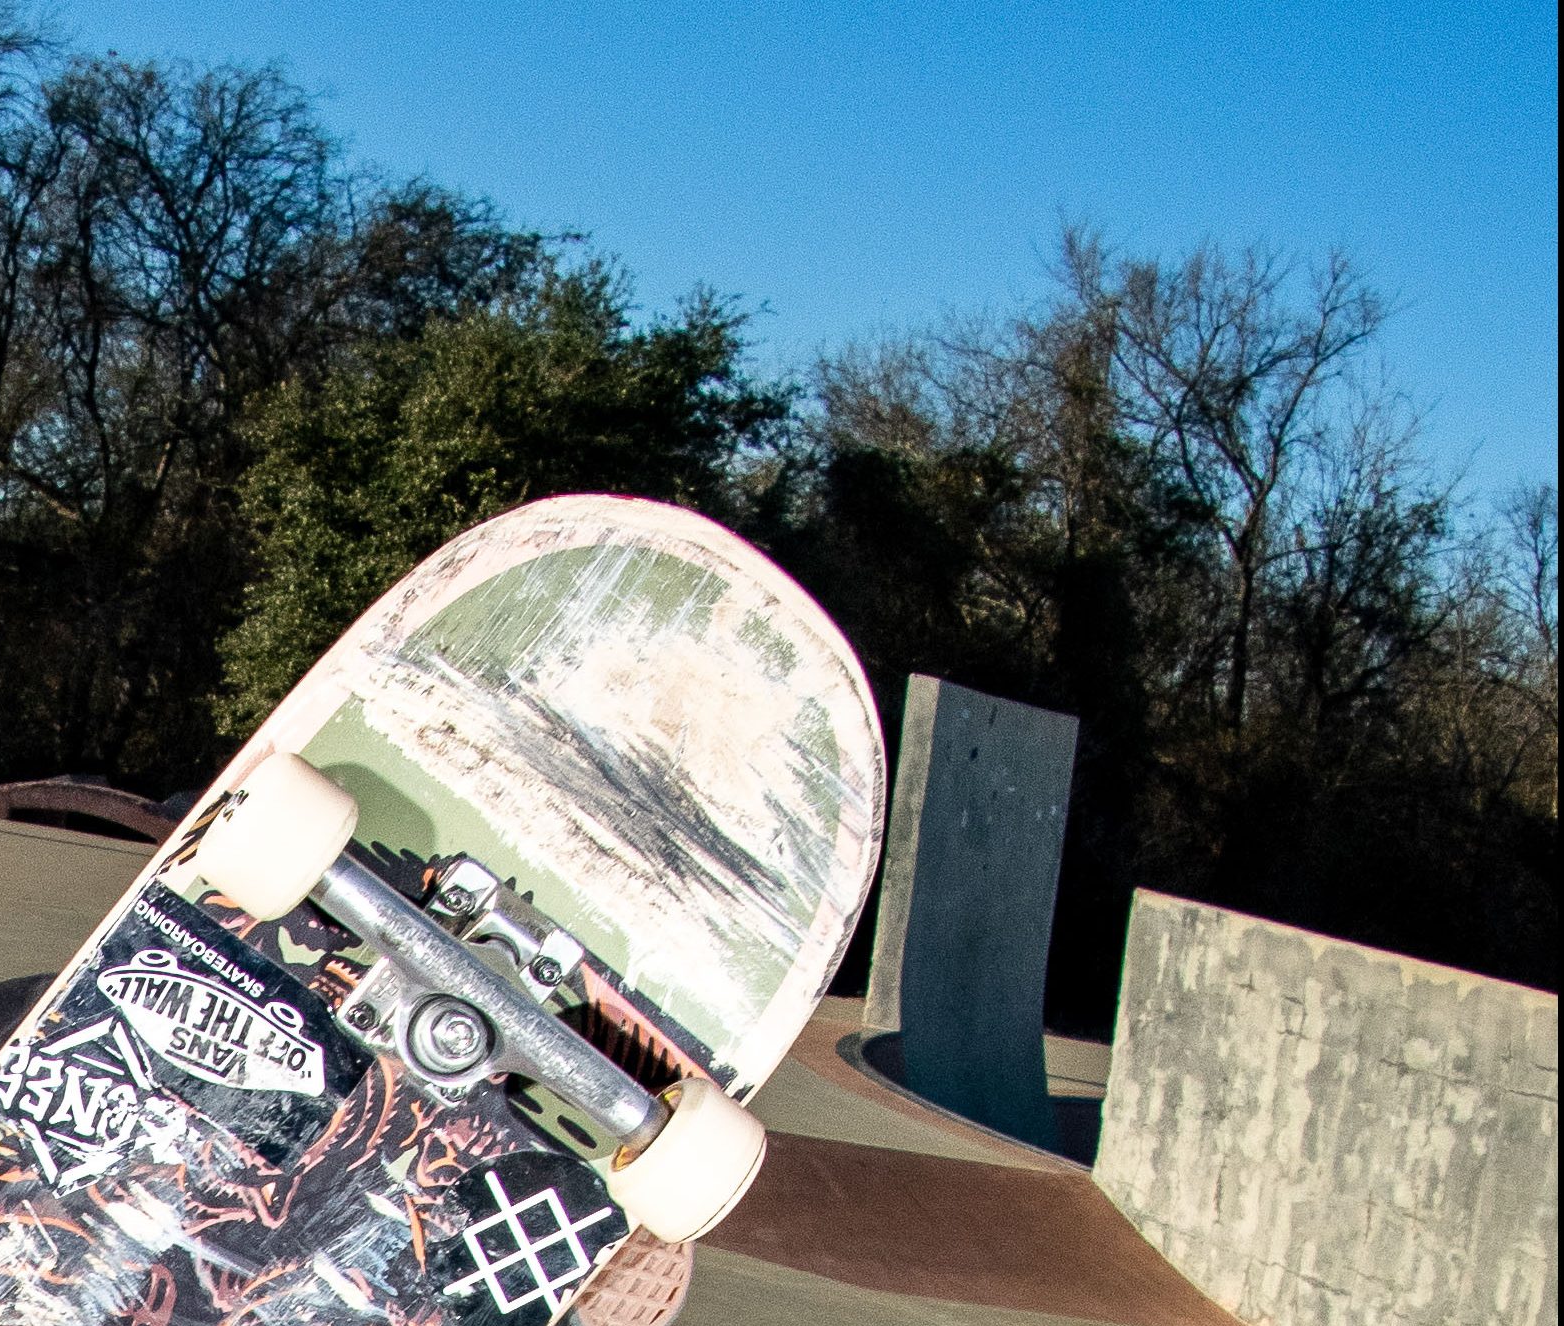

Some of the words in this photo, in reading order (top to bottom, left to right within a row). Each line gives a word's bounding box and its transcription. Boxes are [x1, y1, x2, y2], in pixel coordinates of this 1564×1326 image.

[134, 898, 264, 997] SKATEBOARDING
[189, 991, 255, 1052] THE
[165, 1026, 246, 1082] VANS
